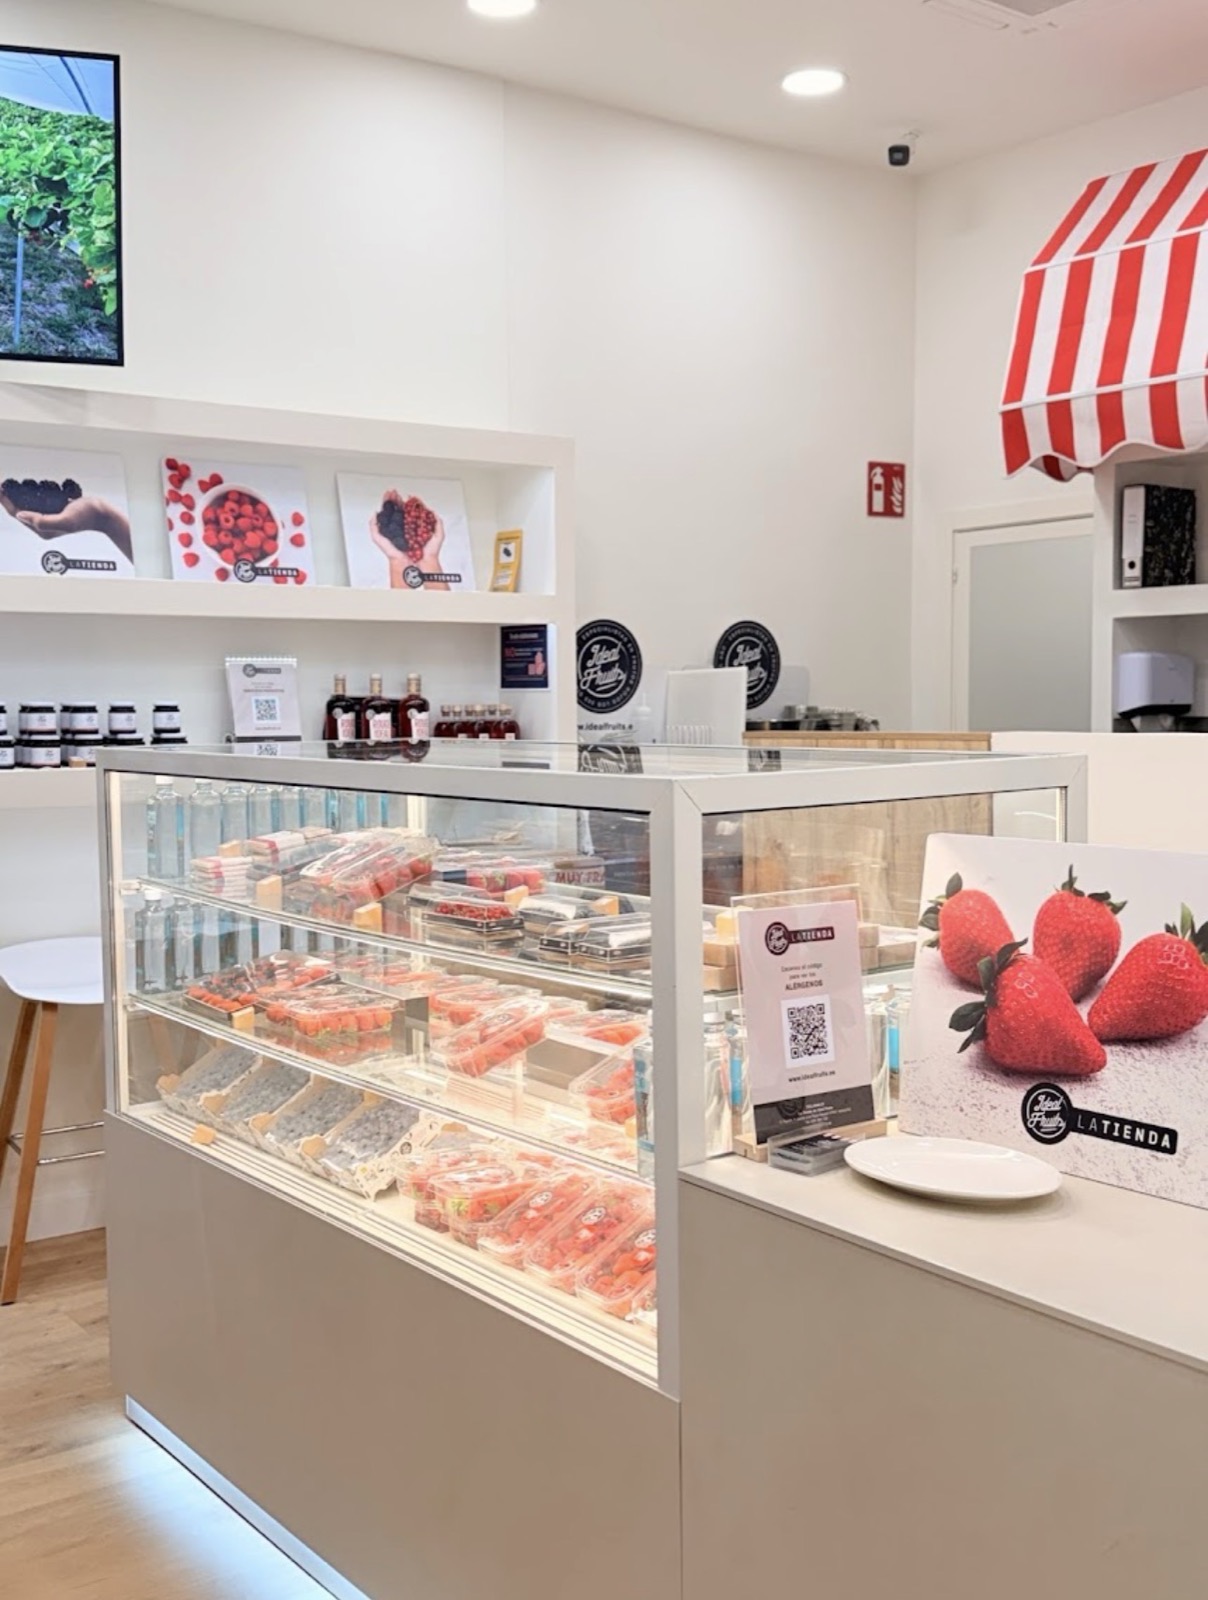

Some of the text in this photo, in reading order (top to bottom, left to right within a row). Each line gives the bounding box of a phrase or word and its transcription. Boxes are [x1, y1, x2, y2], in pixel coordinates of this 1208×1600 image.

[587, 642, 622, 667] Ideal
[733, 642, 763, 666] Ideal
[580, 663, 627, 690] Fruits
[577, 723, 633, 731] w.idealfruits.e
[1033, 1095, 1063, 1112] Ideal
[1027, 1111, 1066, 1129] Fruits
[1077, 1114, 1171, 1149] LATIENDA
